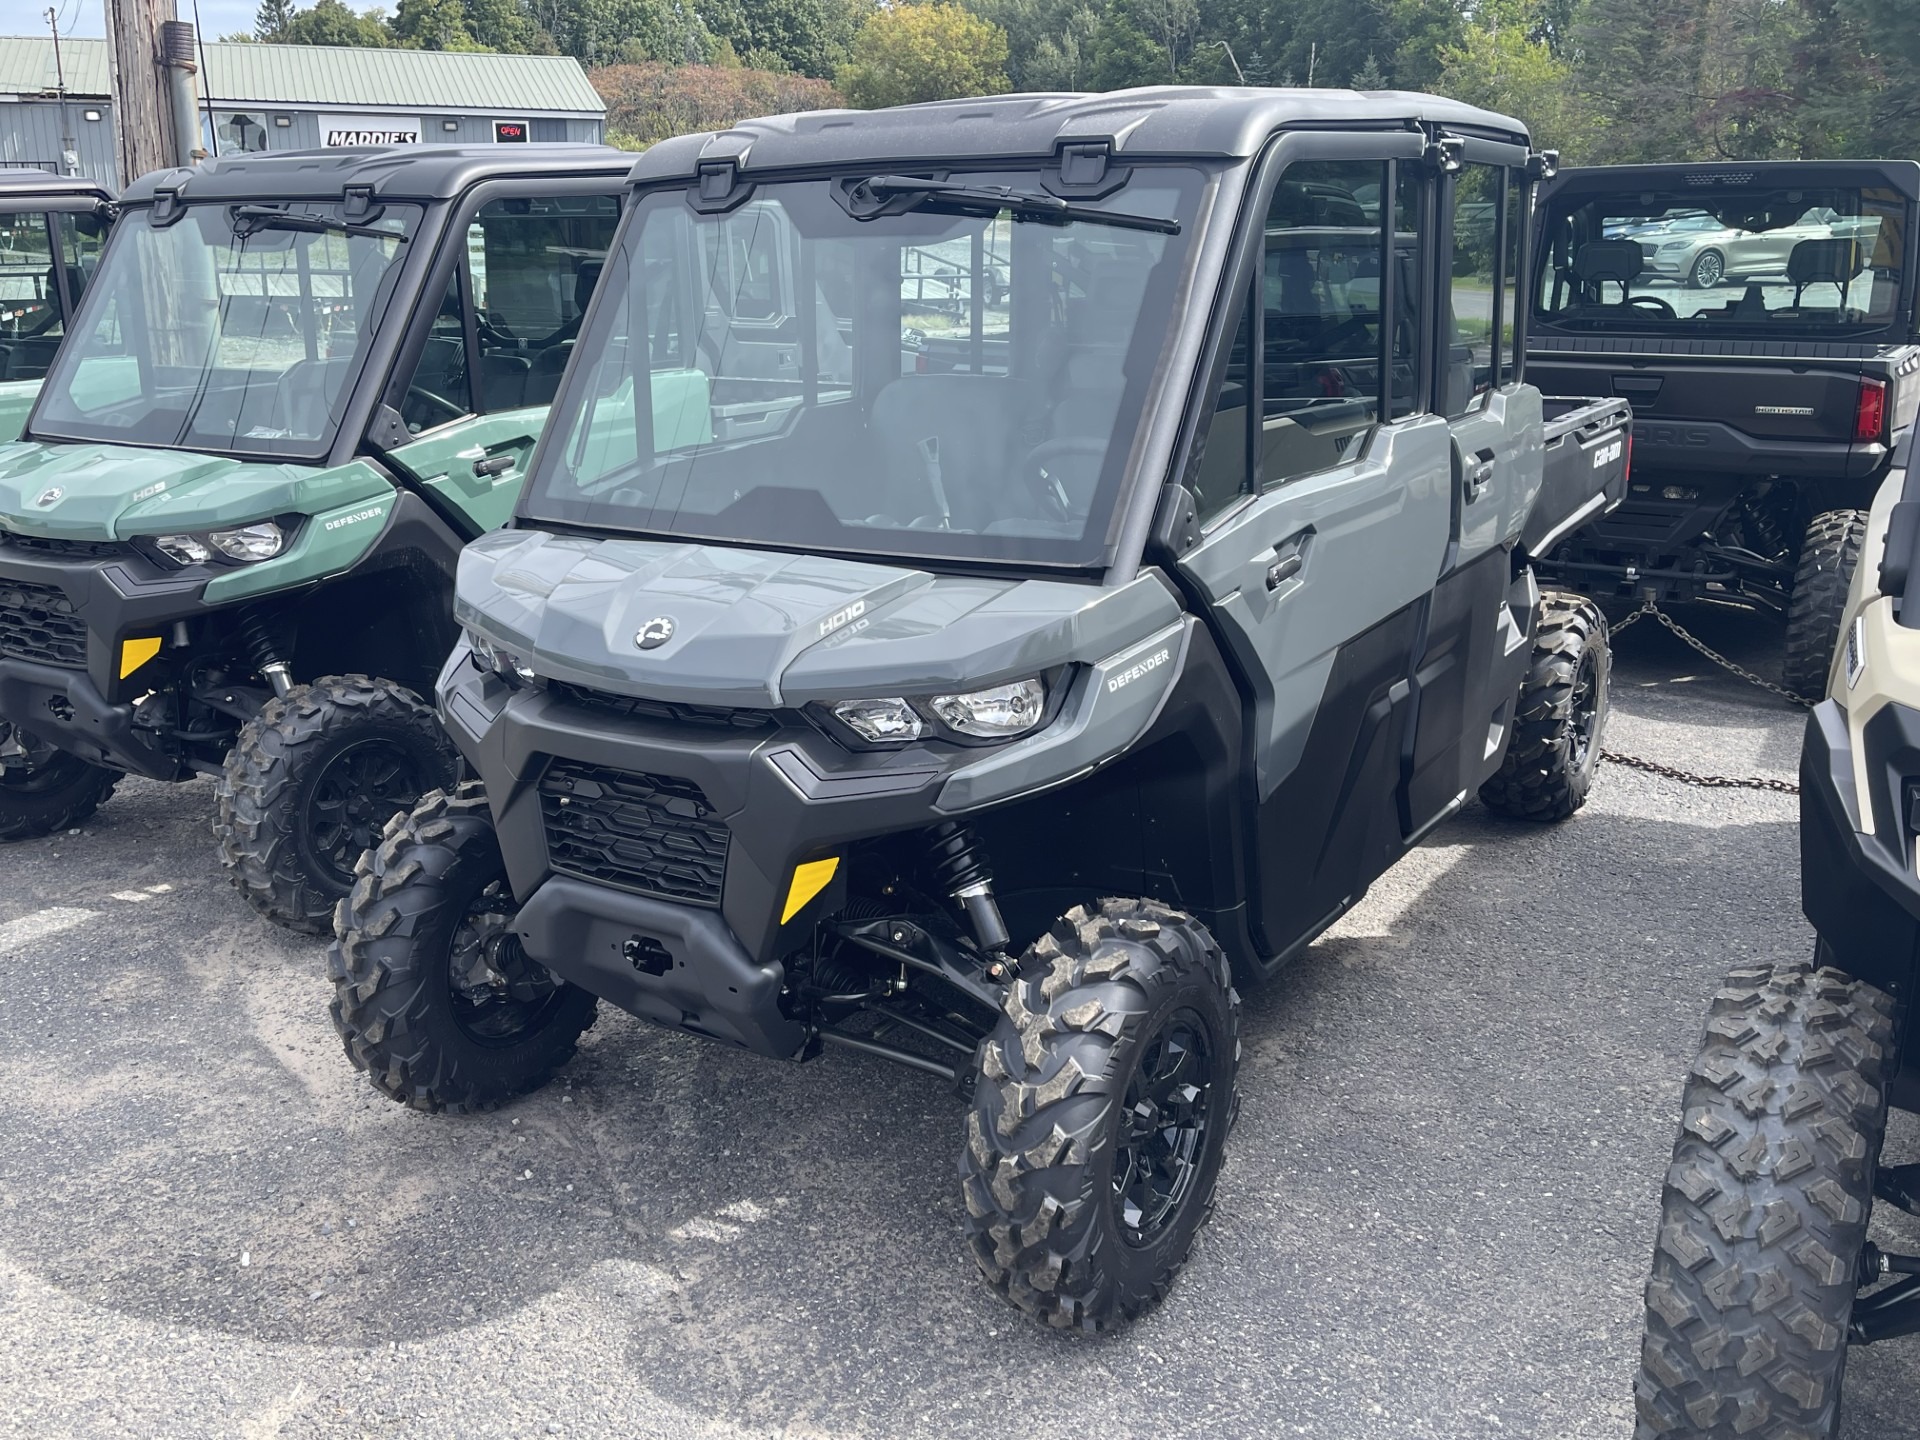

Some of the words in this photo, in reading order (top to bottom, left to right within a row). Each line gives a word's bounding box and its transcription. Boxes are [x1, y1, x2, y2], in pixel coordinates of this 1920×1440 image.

[330, 131, 415, 146] MADDIE'S
[501, 126, 520, 136] OPEN
[1631, 427, 1711, 447] ARIS
[1593, 441, 1621, 468] can-am
[133, 481, 166, 501] HD9
[325, 507, 382, 531] DEFENDER
[819, 600, 865, 636] HD10
[1107, 649, 1170, 693] DEFENDER
